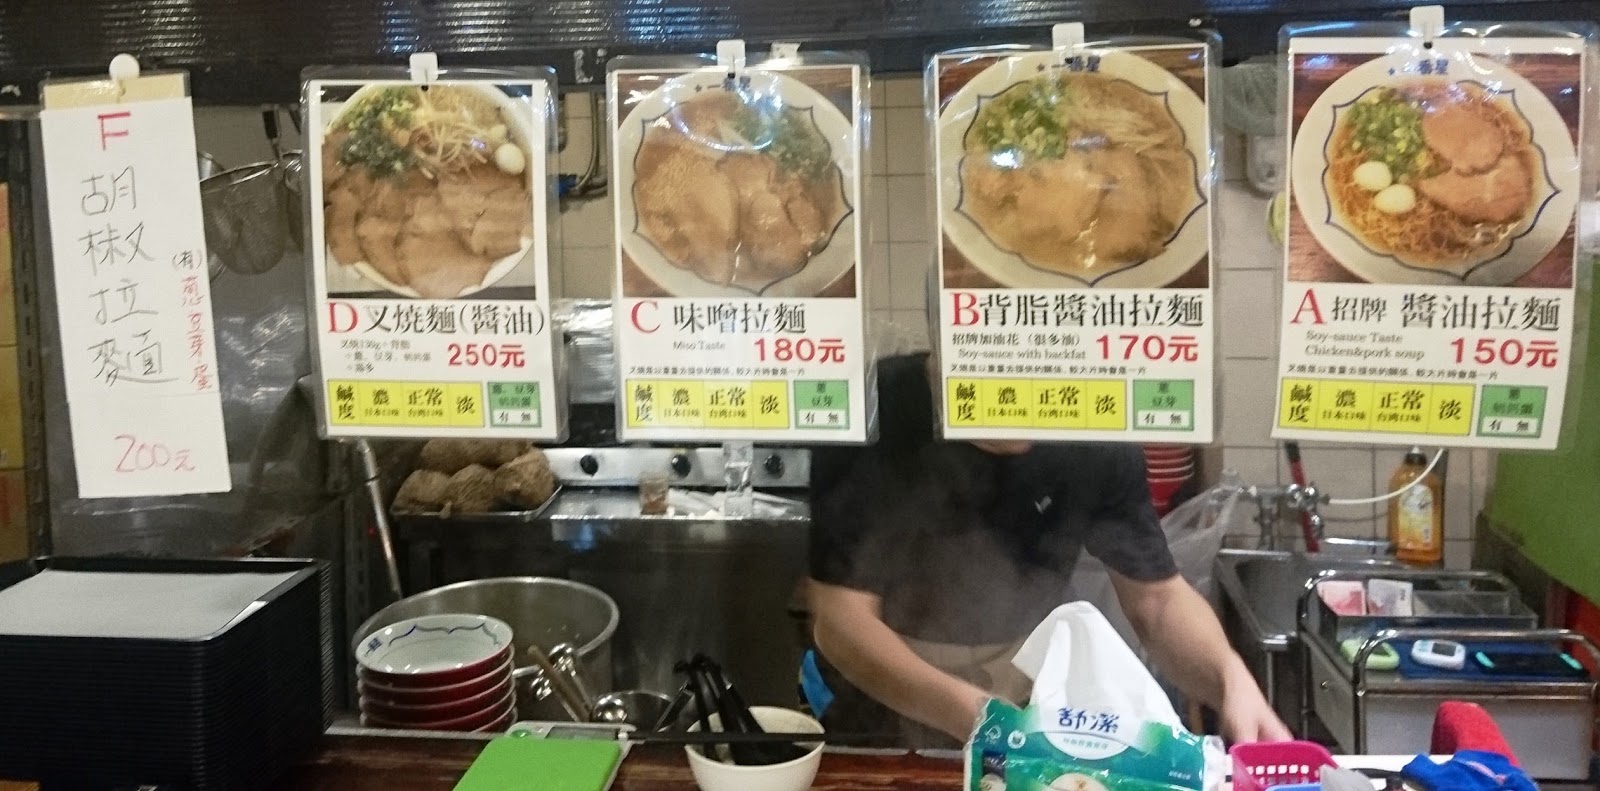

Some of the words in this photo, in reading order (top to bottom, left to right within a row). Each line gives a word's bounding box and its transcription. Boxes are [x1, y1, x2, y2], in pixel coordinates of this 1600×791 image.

[98, 111, 131, 151] F
[77, 165, 179, 388] 胡椒拉麵
[631, 300, 661, 333] C
[1290, 288, 1327, 325] A
[1332, 296, 1388, 323] 招牌
[1400, 292, 1562, 331] 醬油拉麵
[698, 340, 726, 350] Taste
[1097, 335, 1199, 362] 170元
[1305, 330, 1367, 343] Soy-sauce
[1369, 331, 1403, 343] Taste
[448, 343, 526, 368] 250元
[754, 338, 845, 363] 180元
[1018, 349, 1041, 359] with
[1044, 348, 1087, 360] backfat
[1304, 344, 1392, 359] Chicken&pork
[1395, 349, 1425, 362] soup
[1451, 337, 1559, 368] 150元
[407, 388, 443, 405] 正常
[456, 395, 476, 414] 淡
[710, 388, 746, 406] 正常
[760, 395, 780, 415] 淡
[1039, 386, 1080, 406] 正常
[1095, 394, 1116, 415] 淡
[1380, 389, 1424, 411] 正常
[1438, 400, 1462, 420] 淡
[114, 434, 195, 473] 200元
[1058, 708, 1119, 733] 舒潔
